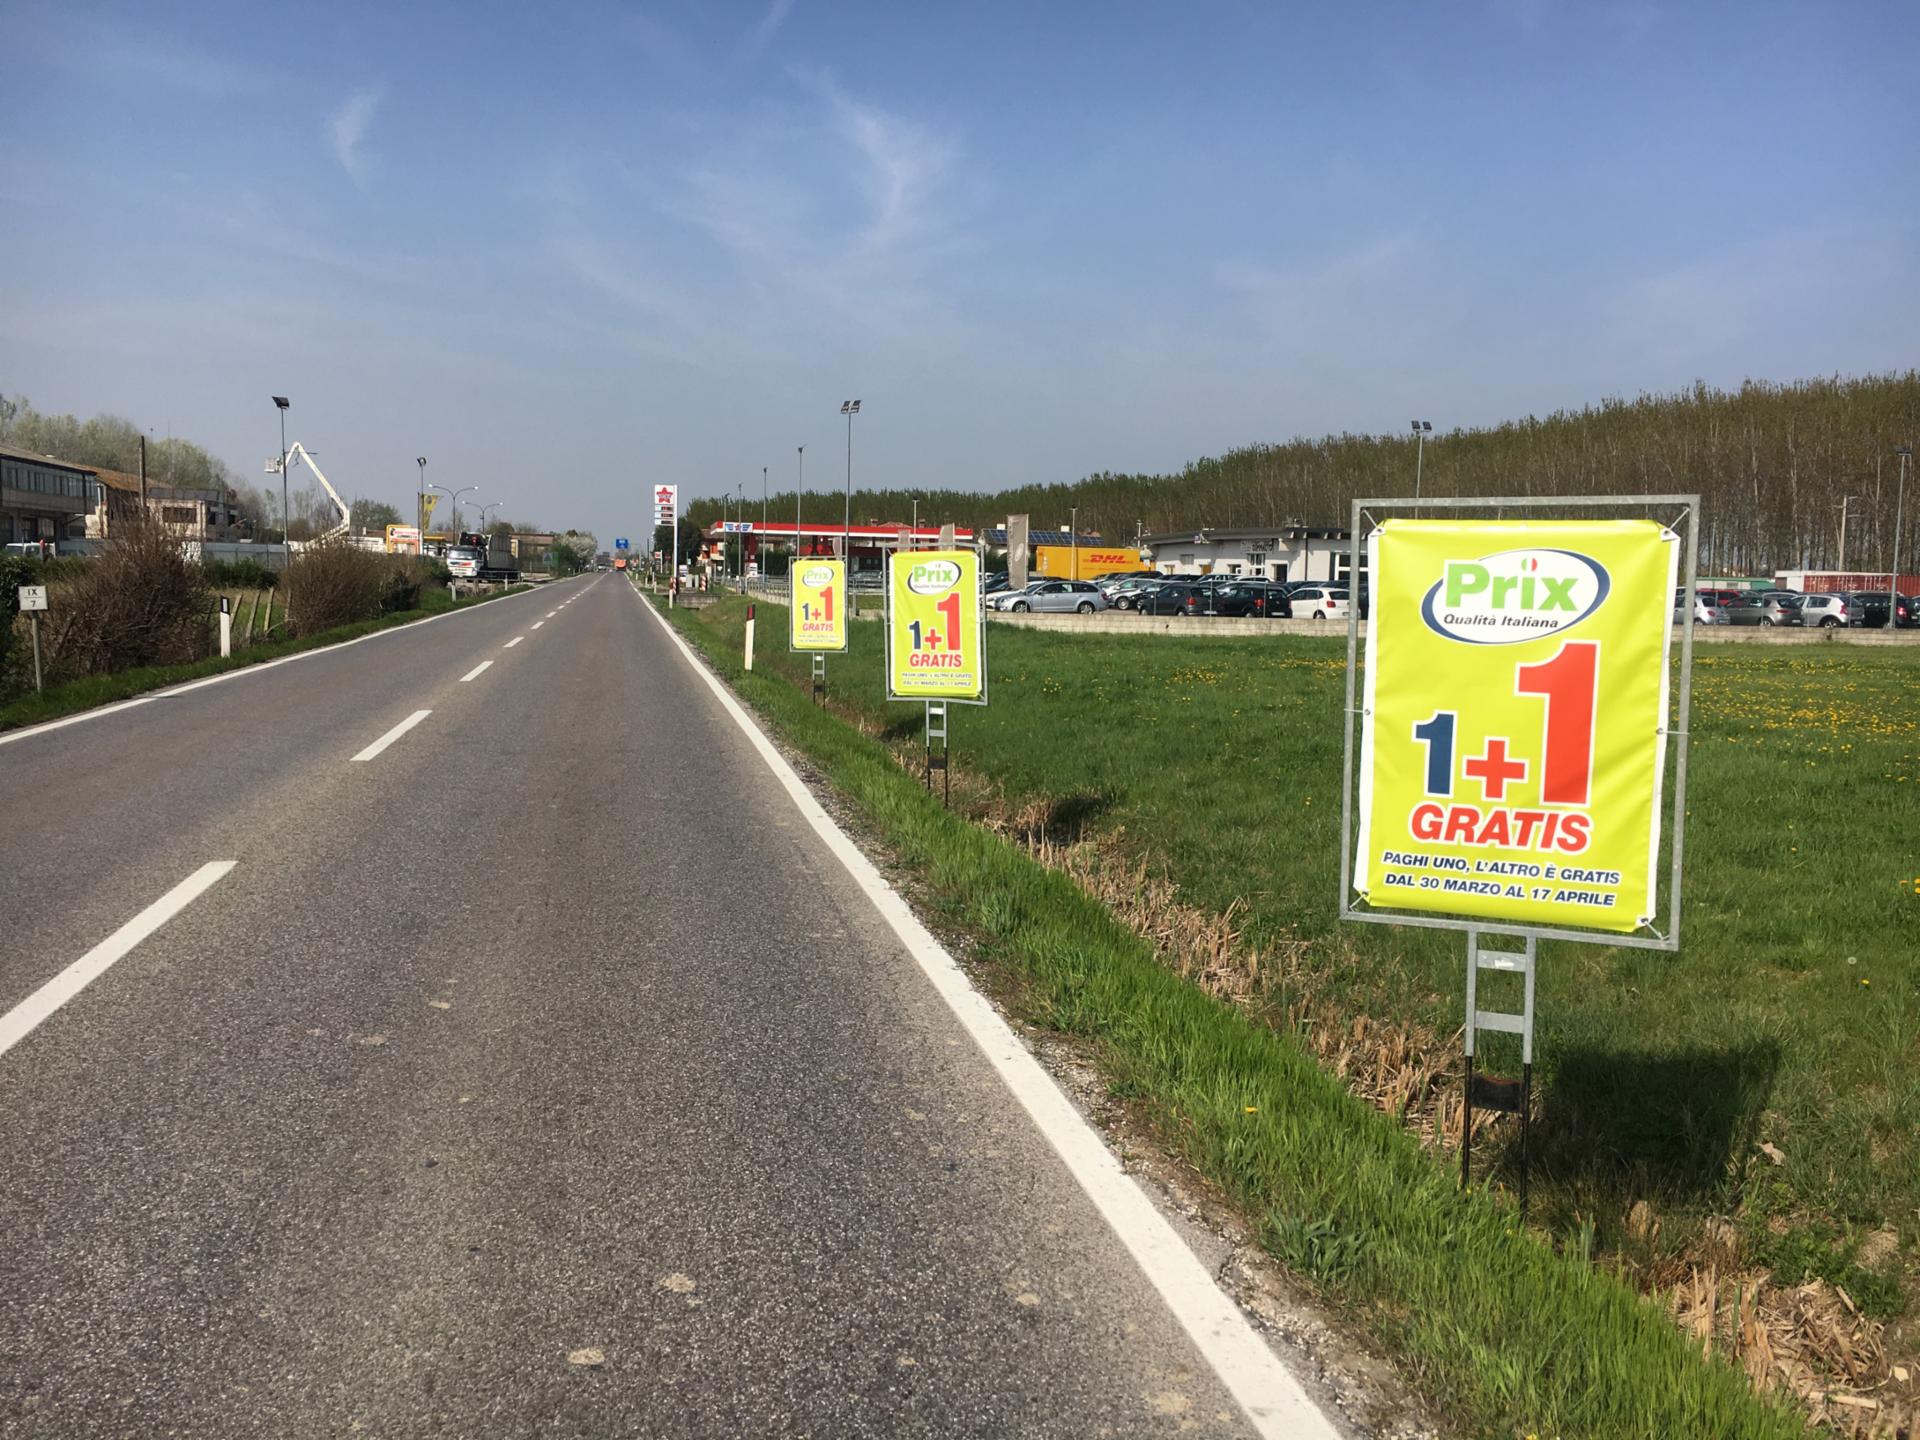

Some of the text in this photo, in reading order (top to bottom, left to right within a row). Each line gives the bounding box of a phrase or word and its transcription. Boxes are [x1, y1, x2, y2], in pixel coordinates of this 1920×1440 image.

[913, 563, 953, 583] Prix
[1090, 555, 1126, 564] DHL
[1445, 558, 1579, 612] Prix
[802, 623, 834, 632] GRATIS
[908, 592, 961, 651] 1+1
[1443, 614, 1559, 628] Qualità Italiana
[909, 653, 962, 668] GRATIS
[1415, 643, 1597, 804] 1+1
[1411, 804, 1590, 851] GRATIS
[1383, 852, 1620, 884] PAGHI UNO, L'ALTRO È GRATIS
[1385, 873, 1615, 906] DAL 30 MARZO AL 17 APRILE
